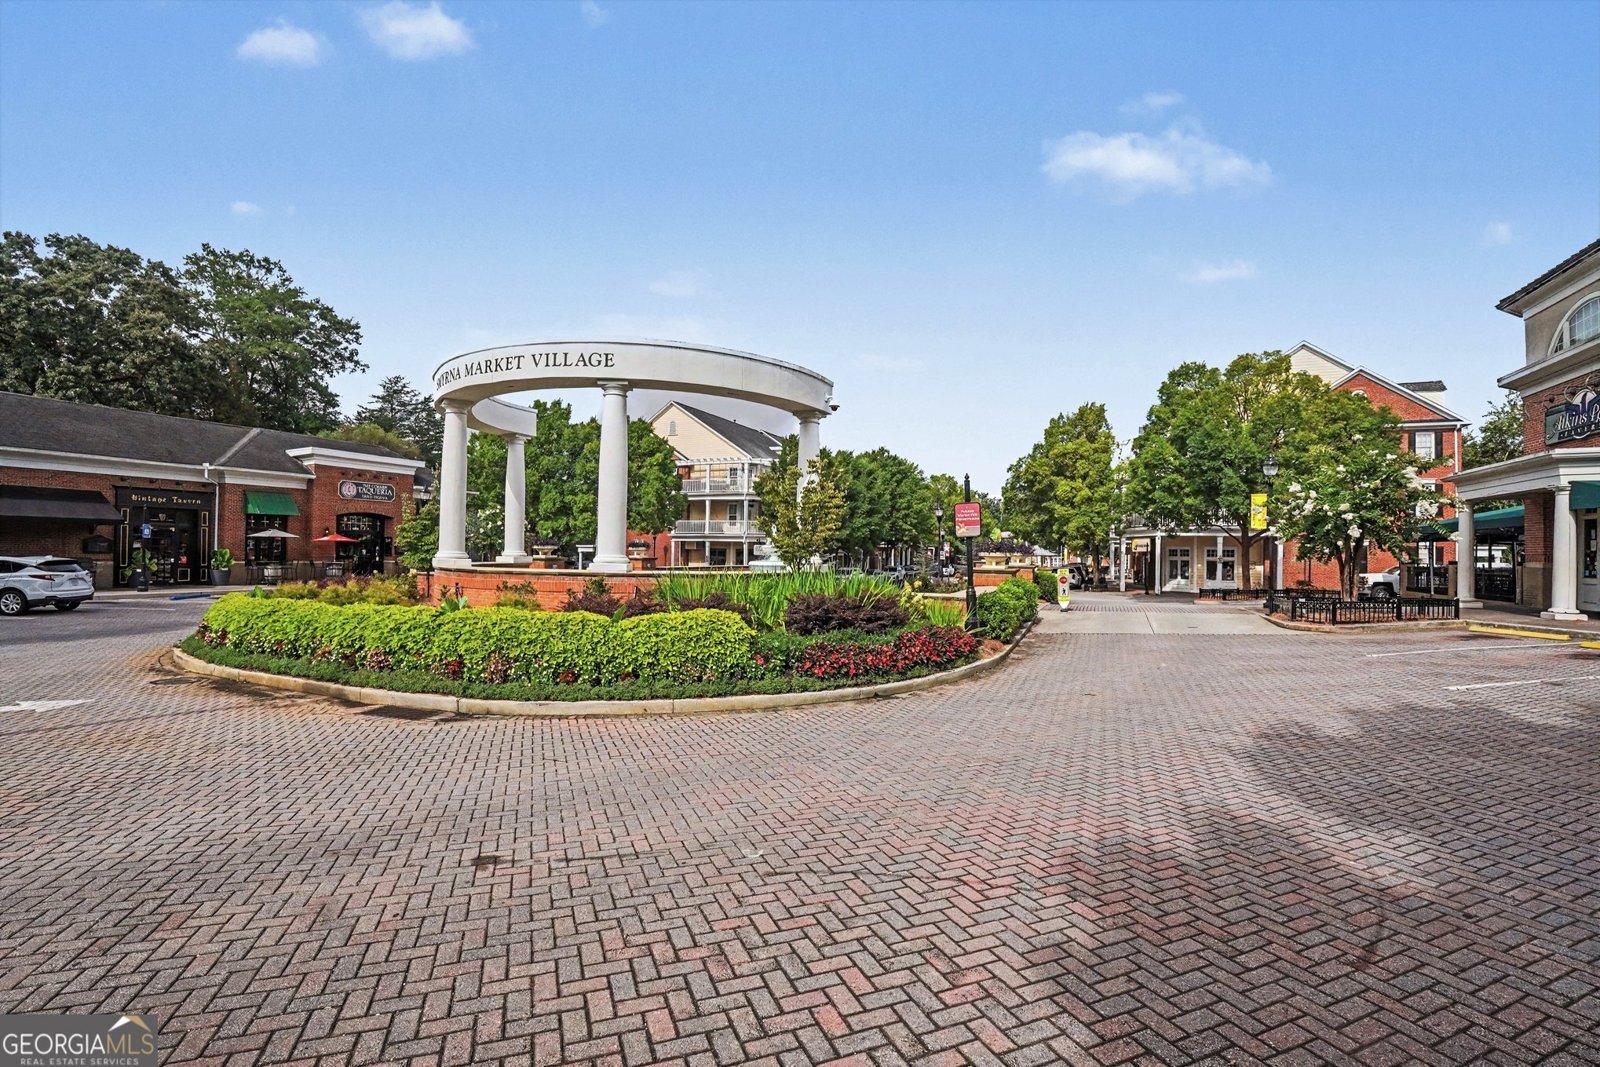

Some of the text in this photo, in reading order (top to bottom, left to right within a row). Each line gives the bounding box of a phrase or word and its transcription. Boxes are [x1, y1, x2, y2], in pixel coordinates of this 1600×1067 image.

[464, 355, 525, 378] MARKET
[531, 352, 615, 368] VILLAGE
[357, 486, 393, 496] TAQUERIA
[131, 494, 201, 505] Vintage Tavern
